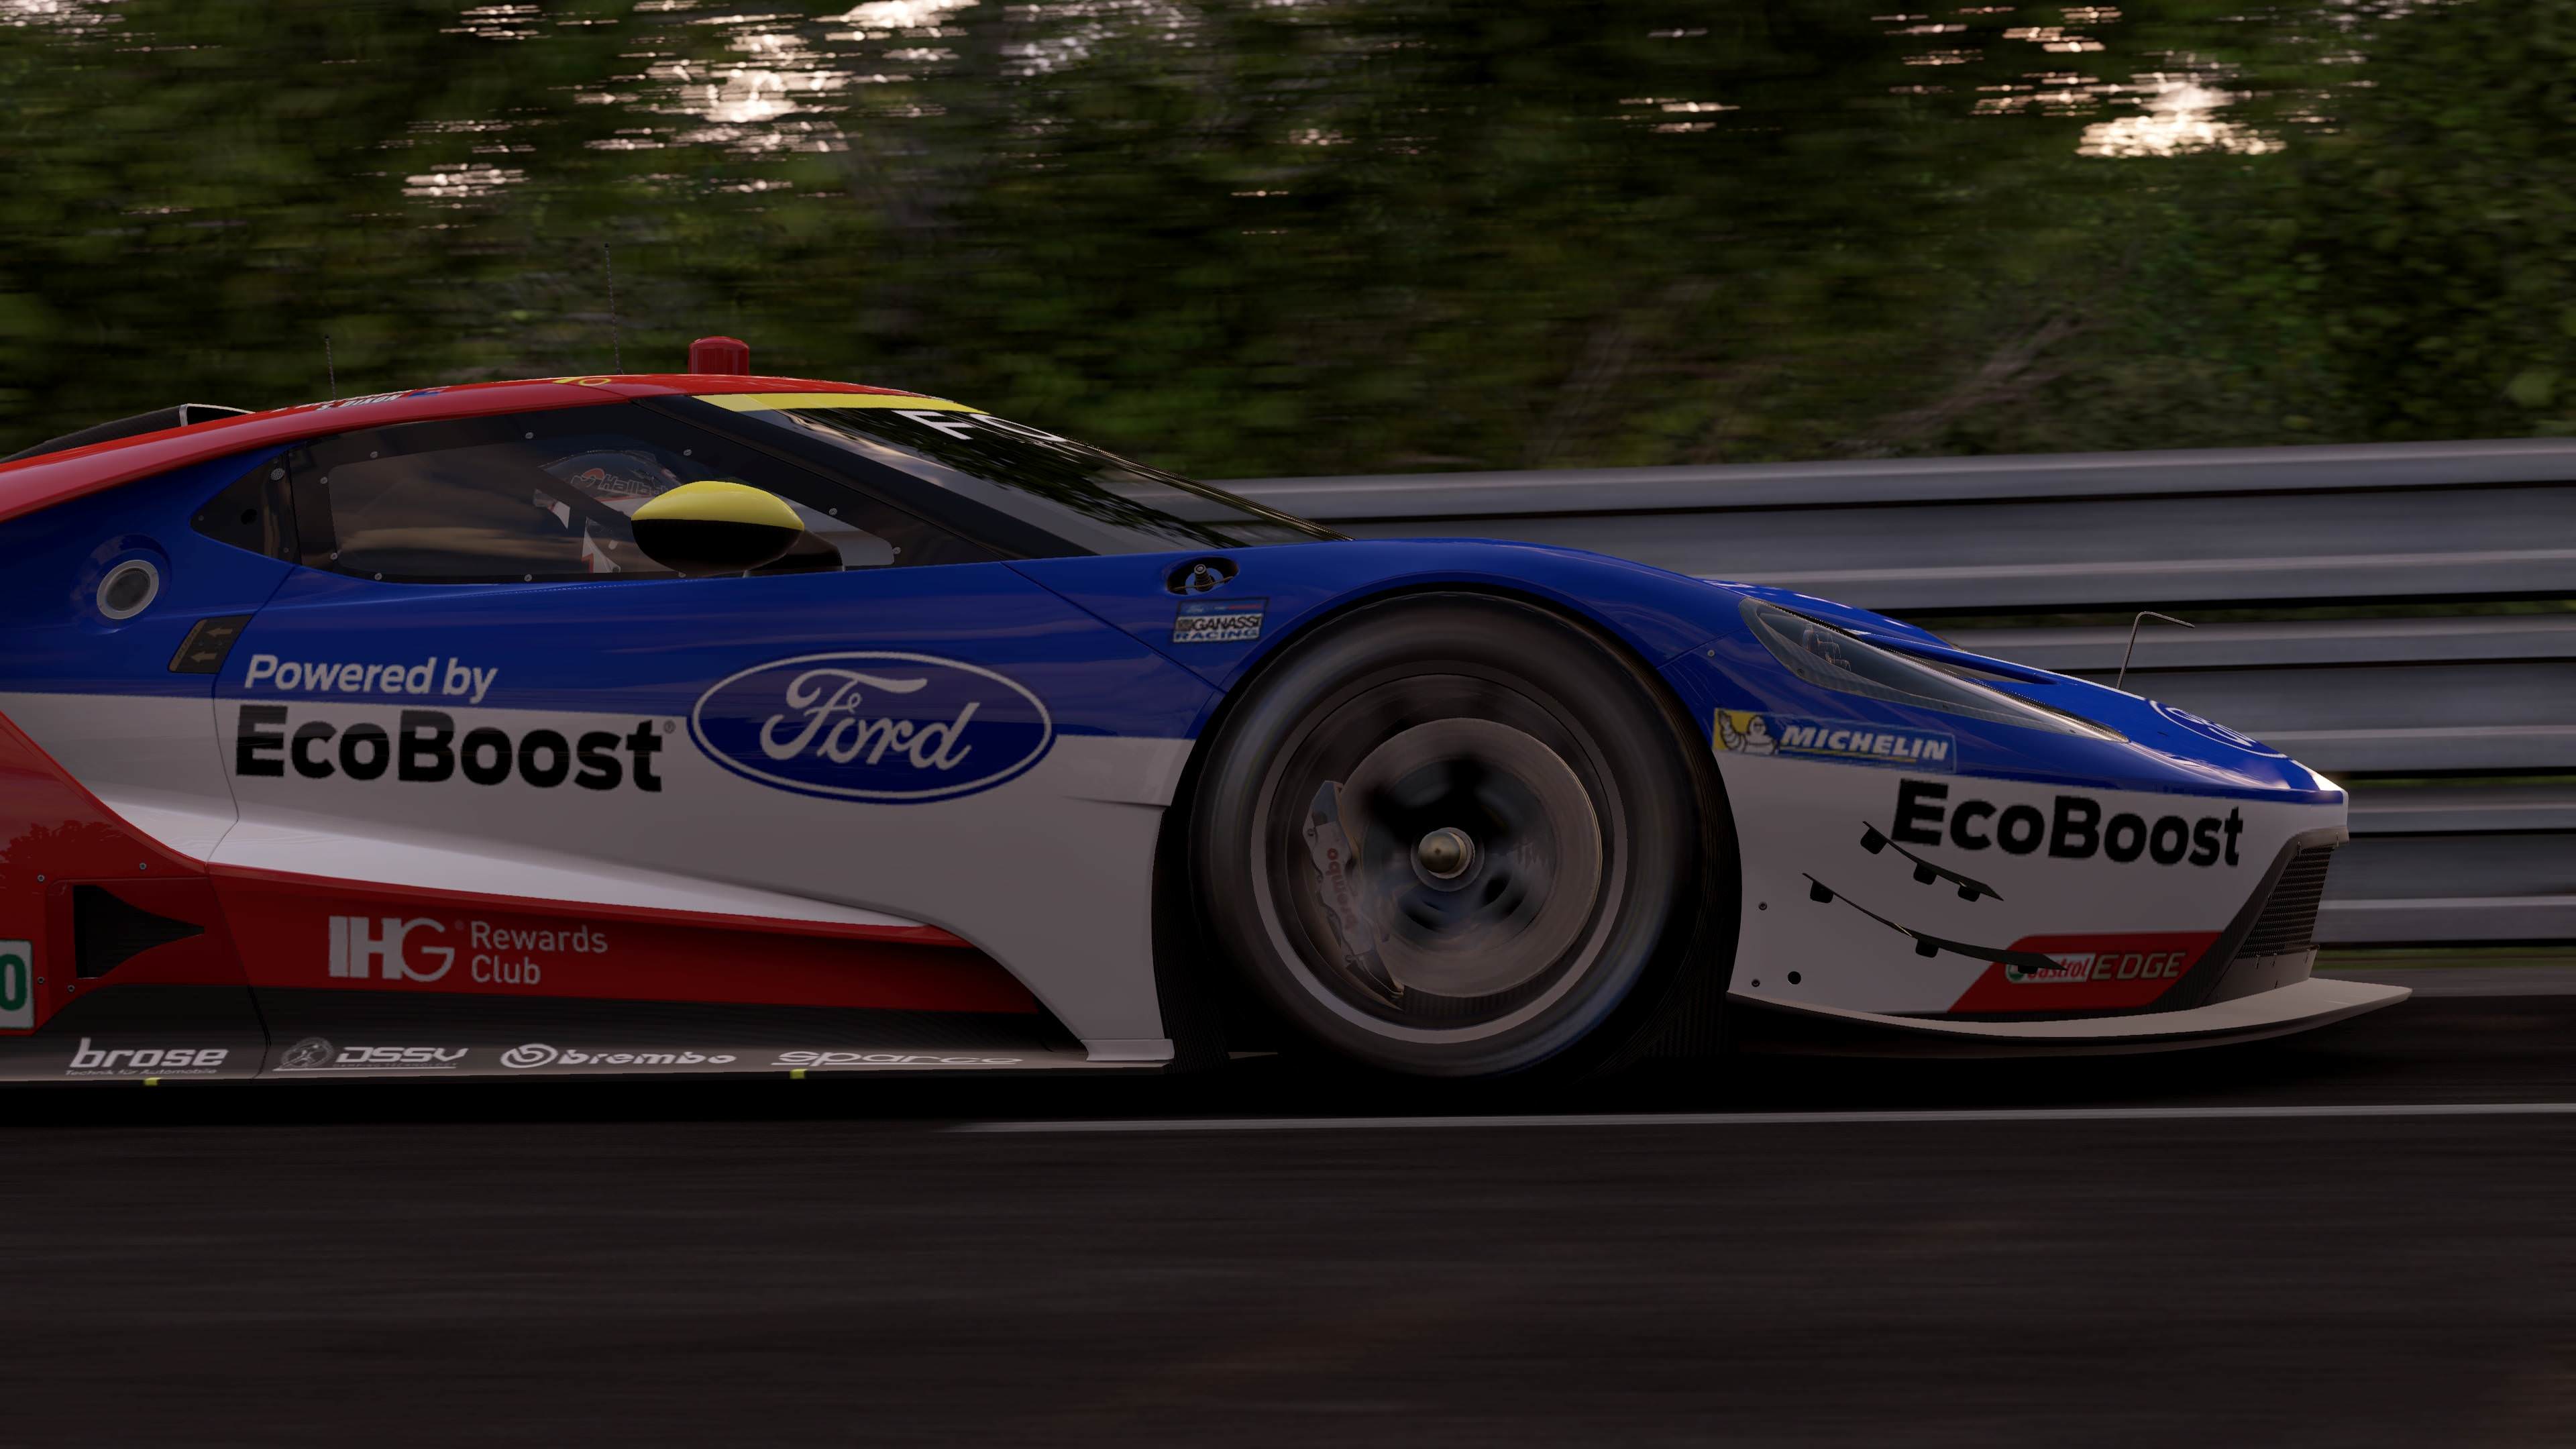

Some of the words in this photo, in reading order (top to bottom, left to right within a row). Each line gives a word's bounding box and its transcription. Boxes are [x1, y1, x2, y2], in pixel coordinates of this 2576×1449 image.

[244, 653, 437, 694] Powered
[442, 657, 498, 704] by
[759, 668, 981, 771] Ford
[235, 704, 663, 793] EcoBoost
[1779, 724, 1949, 761] MICHELIN
[1890, 778, 2244, 867] EcoBoost
[328, 915, 456, 983] IHG
[470, 920, 609, 954] Rewards
[470, 953, 542, 985] Club
[2090, 951, 2187, 980] EDGE
[68, 1036, 230, 1069] brose
[335, 1046, 470, 1063] DSSV
[556, 1049, 738, 1065] brembo
[777, 1051, 1024, 1067] sparco
